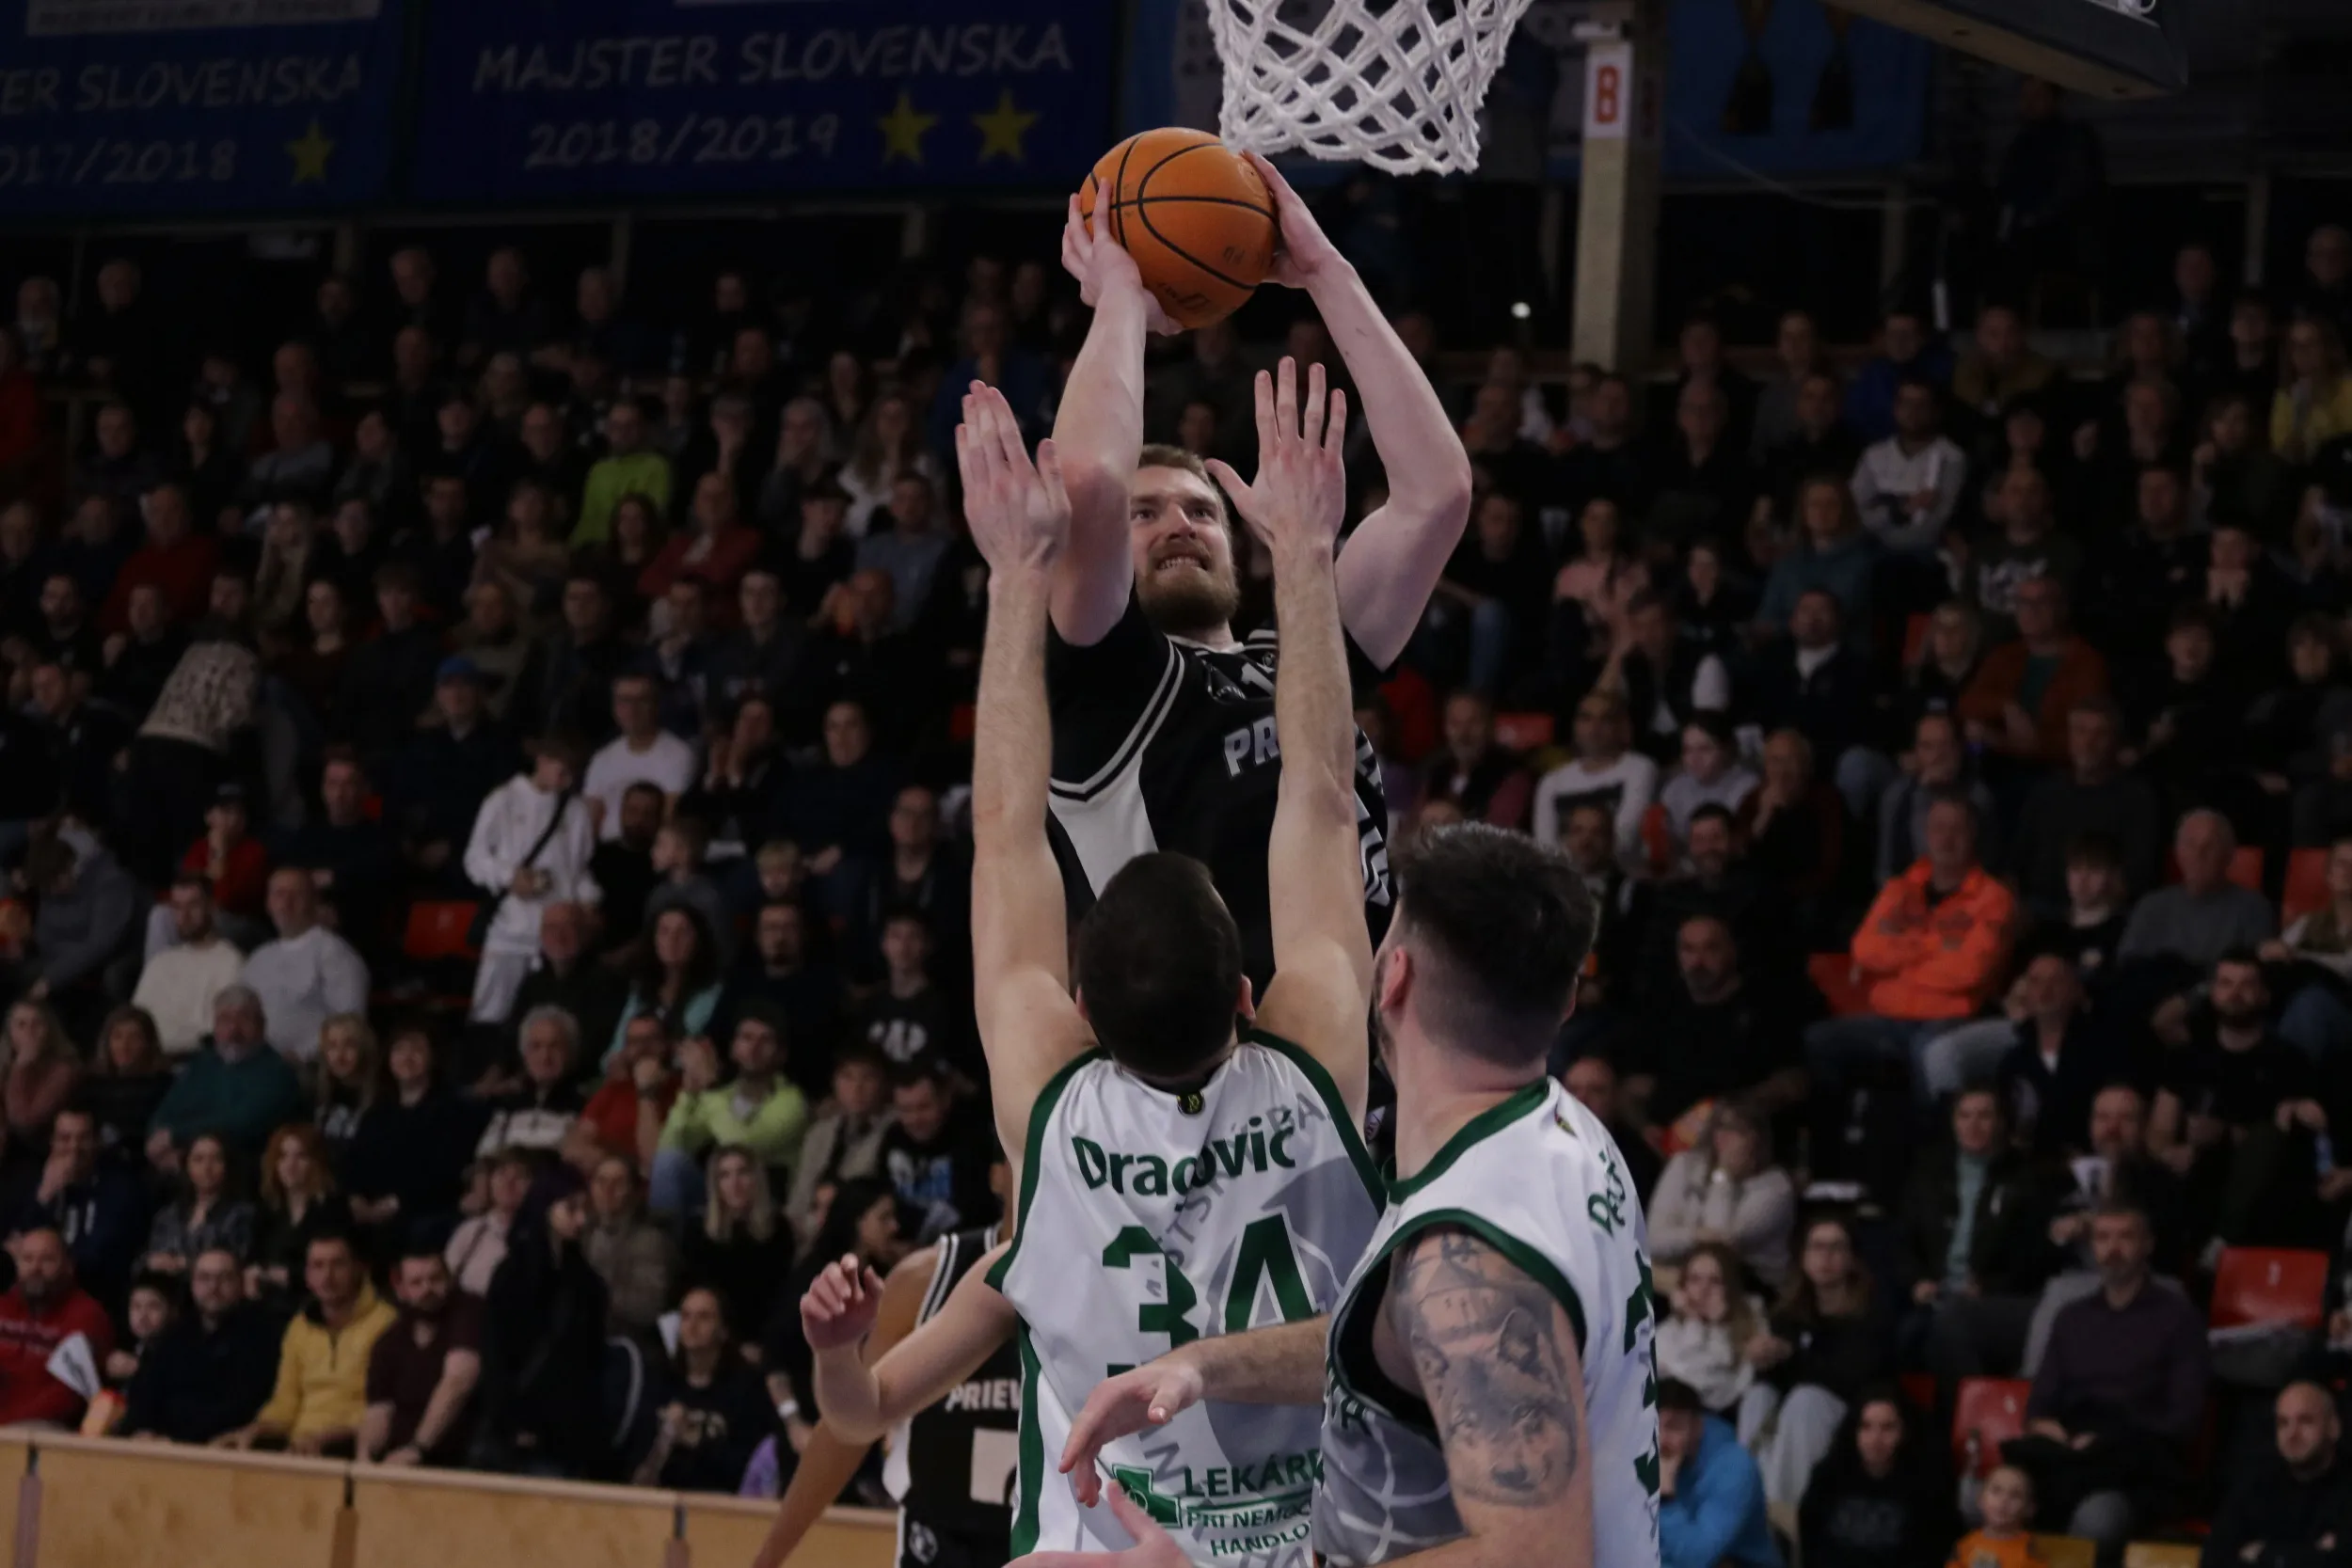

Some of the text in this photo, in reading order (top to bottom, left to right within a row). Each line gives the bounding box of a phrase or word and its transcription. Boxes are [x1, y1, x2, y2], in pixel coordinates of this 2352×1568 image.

[0, 50, 362, 116] ER SLOVENSKA
[472, 21, 1073, 93] MAJSTER SLOVENSKA
[522, 110, 840, 170] 2018/2019
